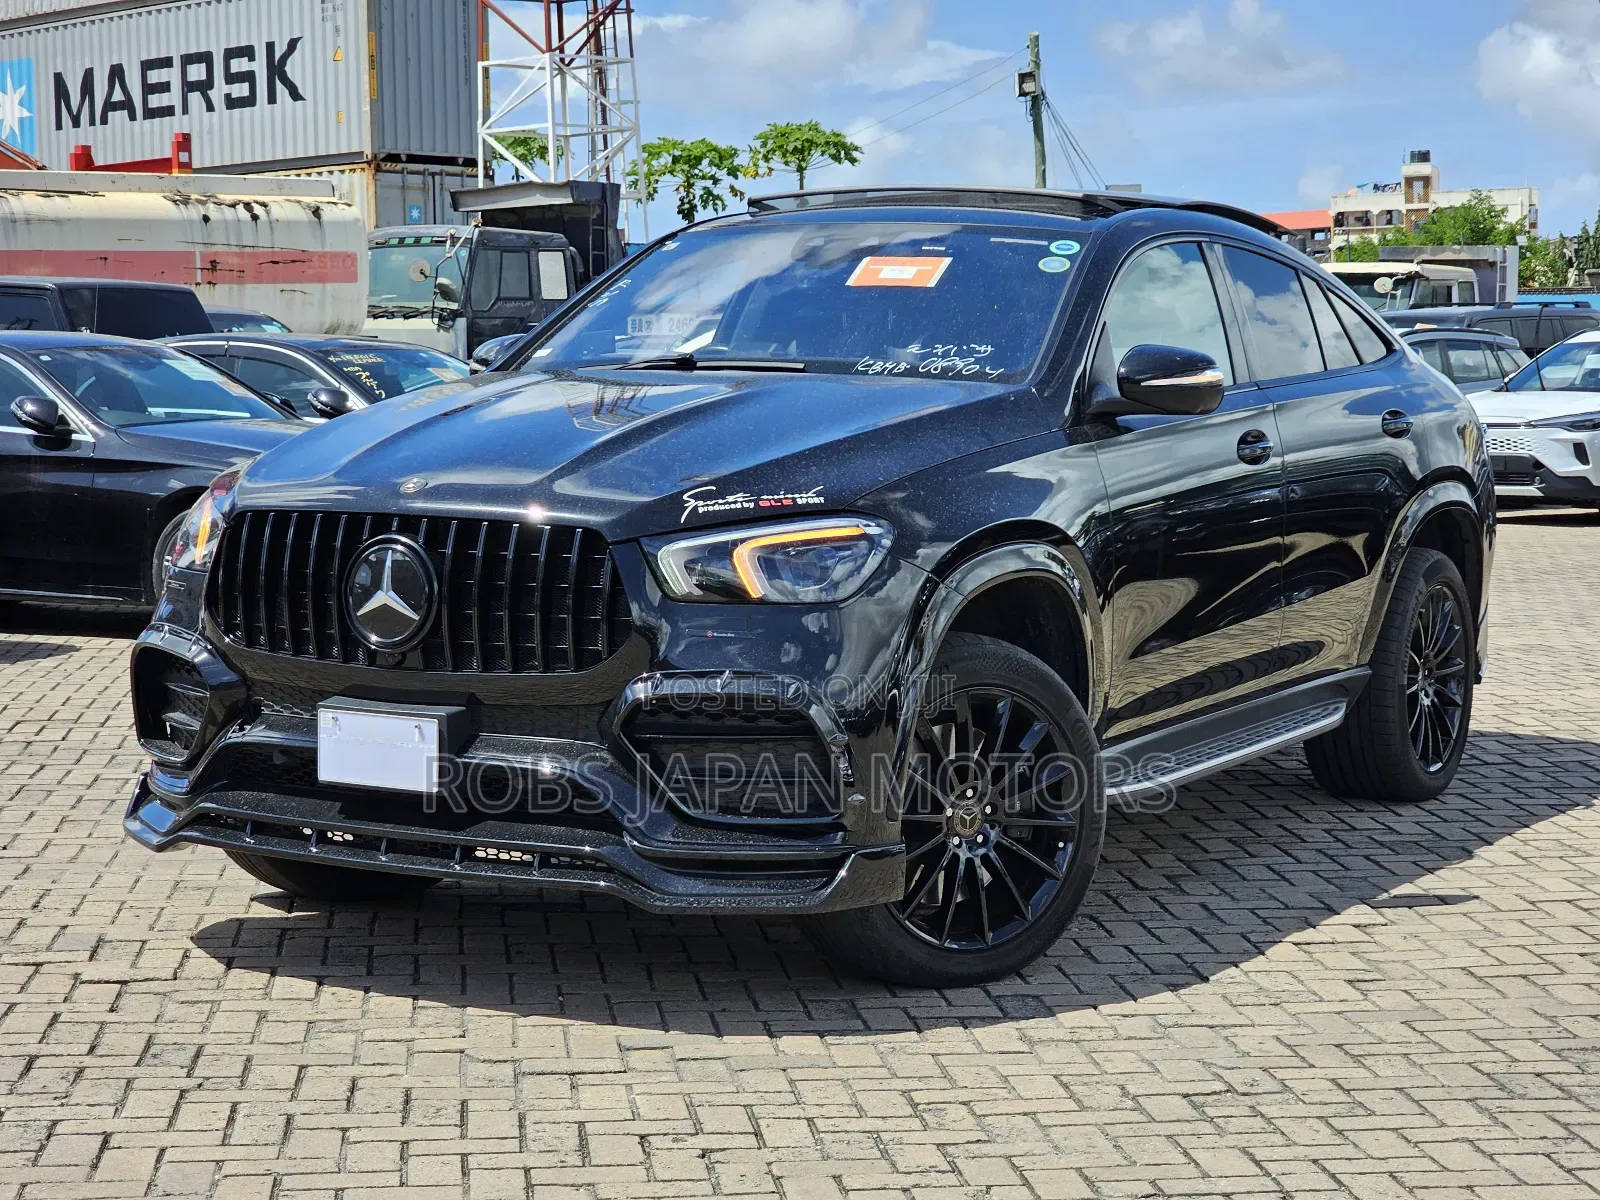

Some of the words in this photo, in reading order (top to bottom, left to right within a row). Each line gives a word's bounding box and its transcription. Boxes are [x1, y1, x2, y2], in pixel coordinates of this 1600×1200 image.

[53, 36, 307, 131] MAERSK
[697, 501, 742, 514] produced
[742, 500, 755, 510] by
[758, 499, 794, 508] GLE
[796, 496, 826, 506] SPORT
